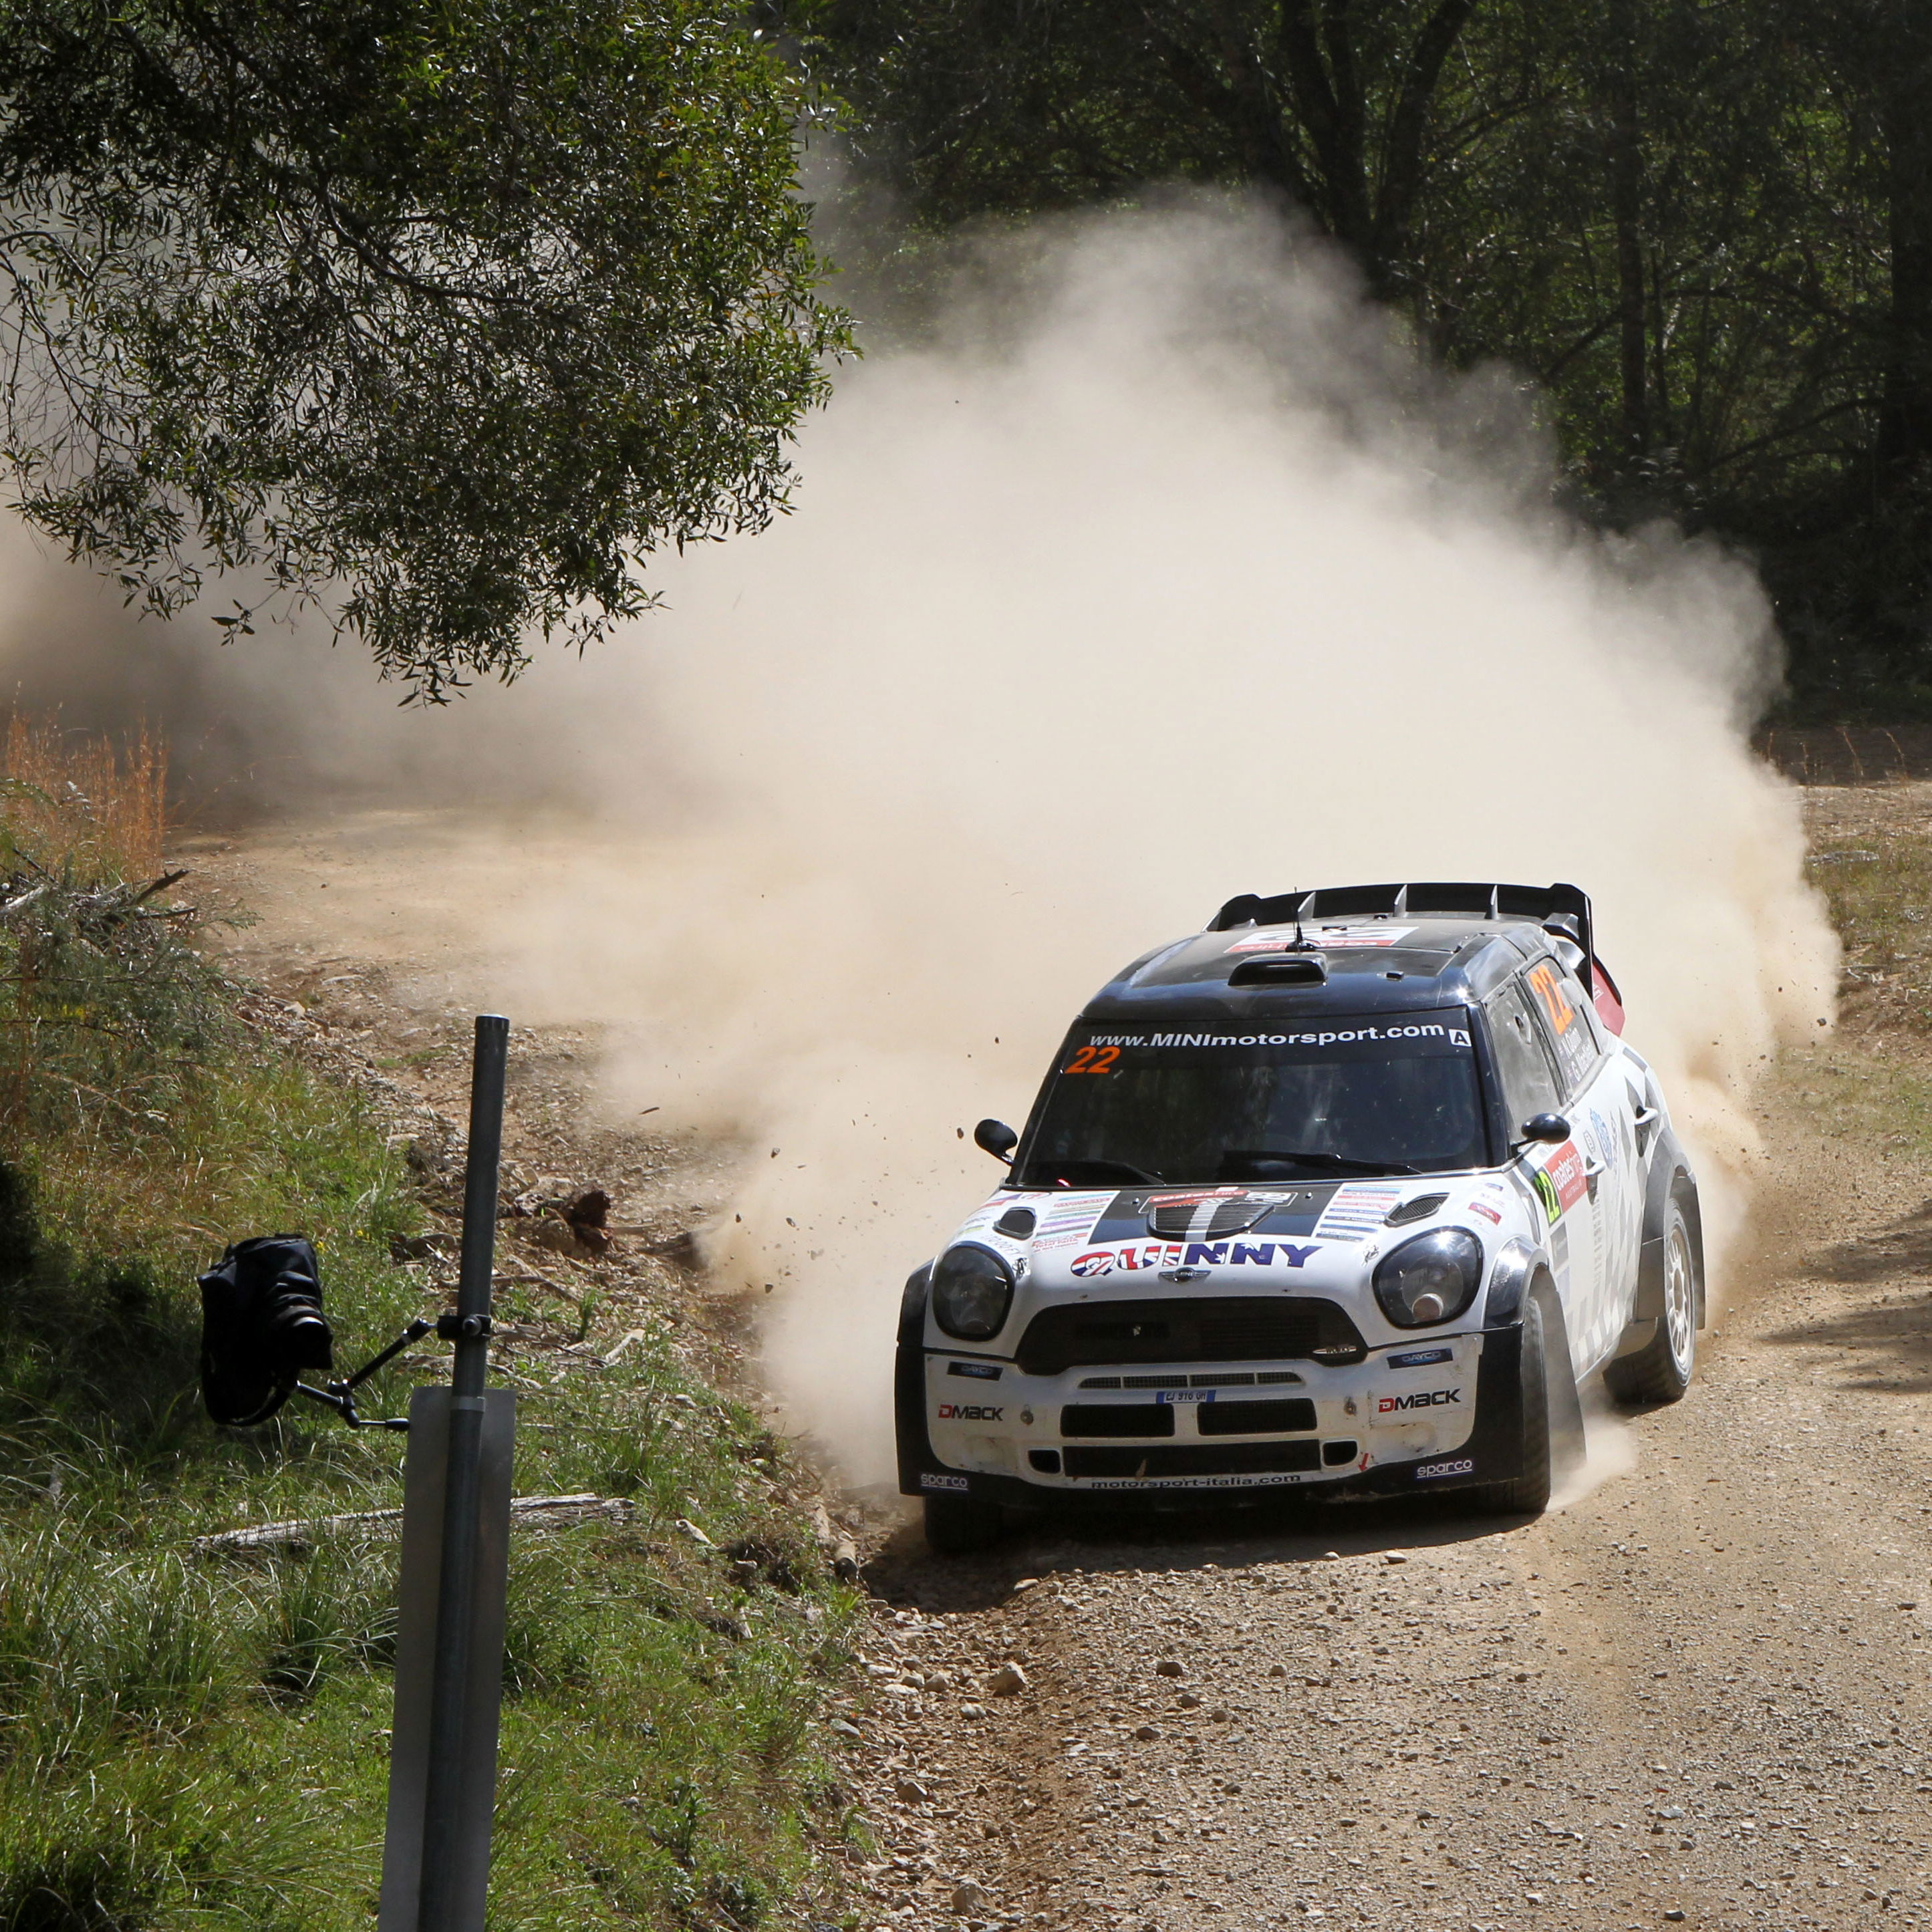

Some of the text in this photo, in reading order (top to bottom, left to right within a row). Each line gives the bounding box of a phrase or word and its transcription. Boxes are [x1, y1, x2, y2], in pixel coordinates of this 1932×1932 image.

[1530, 964, 1574, 1035] 22
[1089, 1024, 1470, 1047] www.MINImotorsport.com A
[1065, 1047, 1121, 1074] 22
[1534, 1171, 1562, 1225] 22
[1070, 1242, 1325, 1277] QUINNY
[1401, 1351, 1441, 1363] DAYCO
[1417, 1459, 1473, 1478] sparco
[920, 1473, 968, 1489] sparco
[1091, 1474, 1301, 1489] motorsport-italia.com
